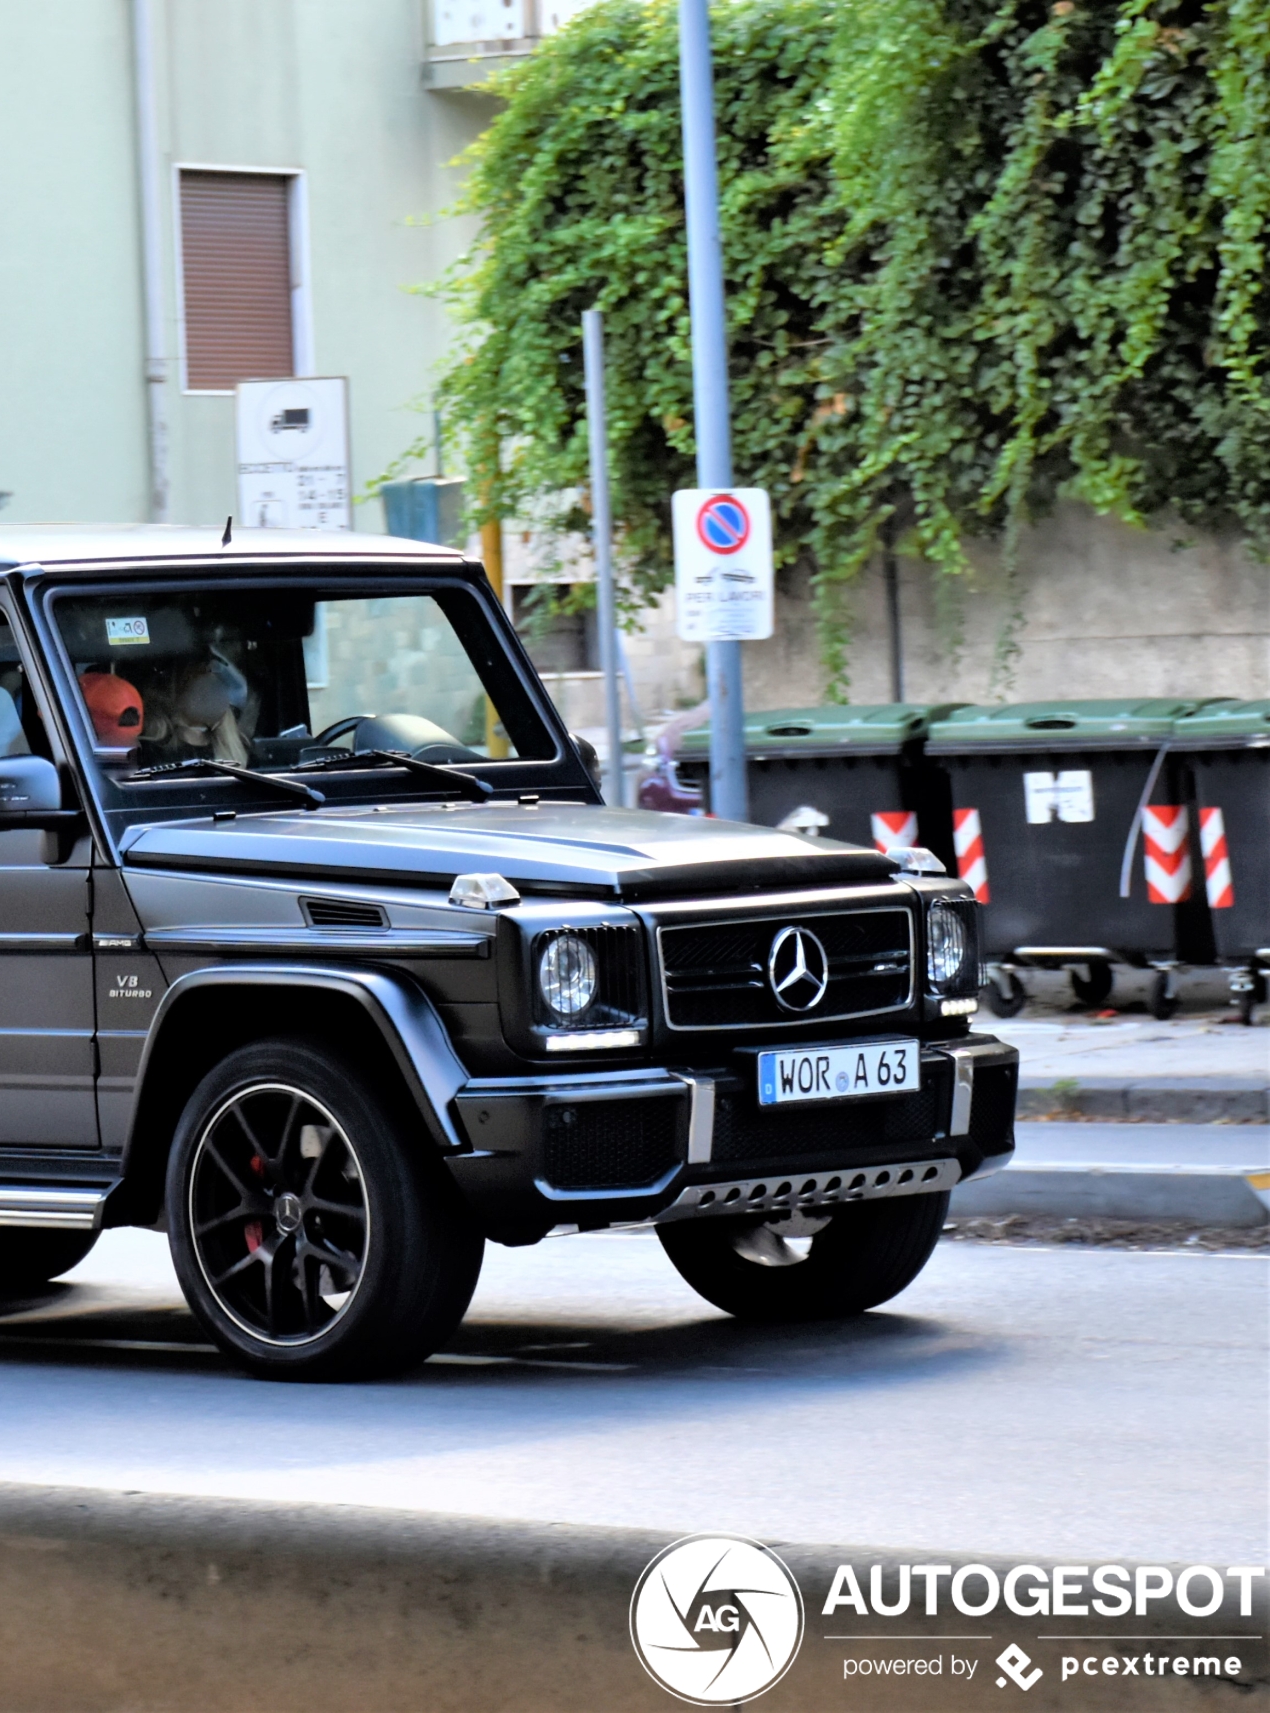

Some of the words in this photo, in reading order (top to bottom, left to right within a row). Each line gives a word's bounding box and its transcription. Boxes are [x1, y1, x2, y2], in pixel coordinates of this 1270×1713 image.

[685, 592, 712, 603] PER
[718, 590, 764, 603] LAVORI
[108, 939, 132, 947] AMG
[116, 975, 138, 988] V8
[109, 989, 152, 998] BITURBO
[764, 1083, 773, 1095] D
[779, 1055, 831, 1095] WOR
[853, 1052, 869, 1089] A
[877, 1048, 907, 1086] 63
